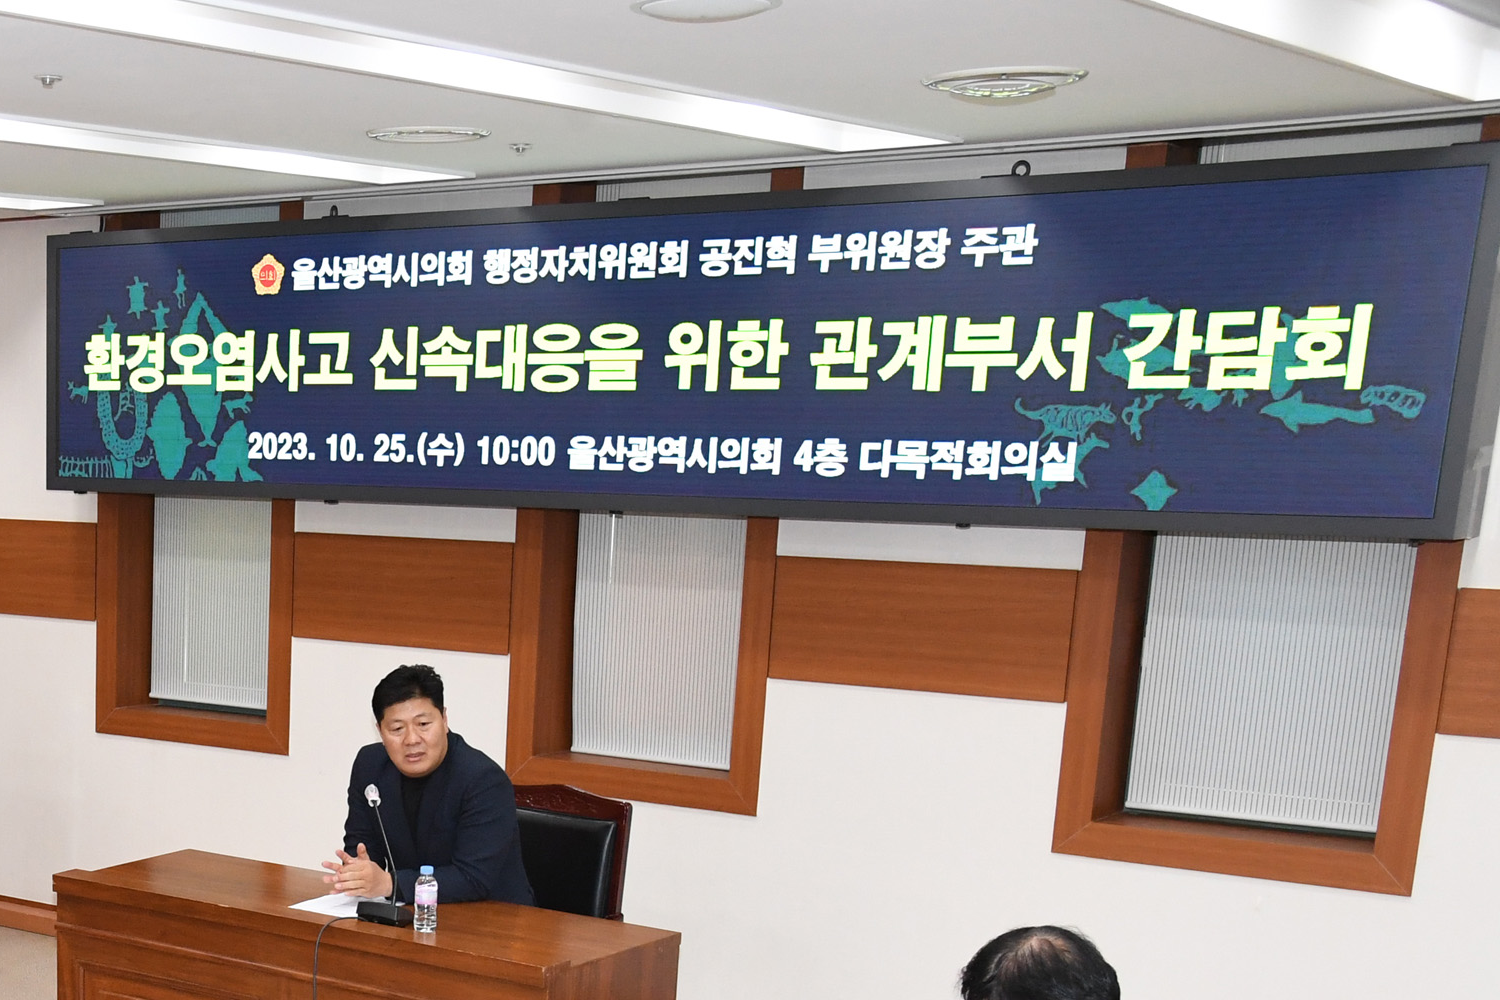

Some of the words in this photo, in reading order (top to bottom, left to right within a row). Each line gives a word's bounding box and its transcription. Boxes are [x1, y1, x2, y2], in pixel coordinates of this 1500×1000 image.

[291, 248, 474, 291] 울산광역시의회
[483, 239, 689, 285] 행정자치위원회
[699, 234, 798, 277] 공진혁
[808, 227, 951, 272] 부위원장
[961, 223, 1039, 267] 주관
[84, 329, 353, 393] 환경오염사고
[370, 324, 643, 393] 신속대응을
[665, 319, 789, 392] 위한
[810, 312, 1093, 392] 관계부서
[1123, 304, 1373, 390] 간담회
[248, 431, 316, 461] 2023.
[326, 432, 364, 462] 10.
[374, 431, 465, 467] 25.(수)
[477, 435, 556, 467] 10:00
[567, 436, 782, 476] 울산광역시의회
[794, 437, 849, 478] 4층
[860, 439, 1078, 482] 다목적회의실
